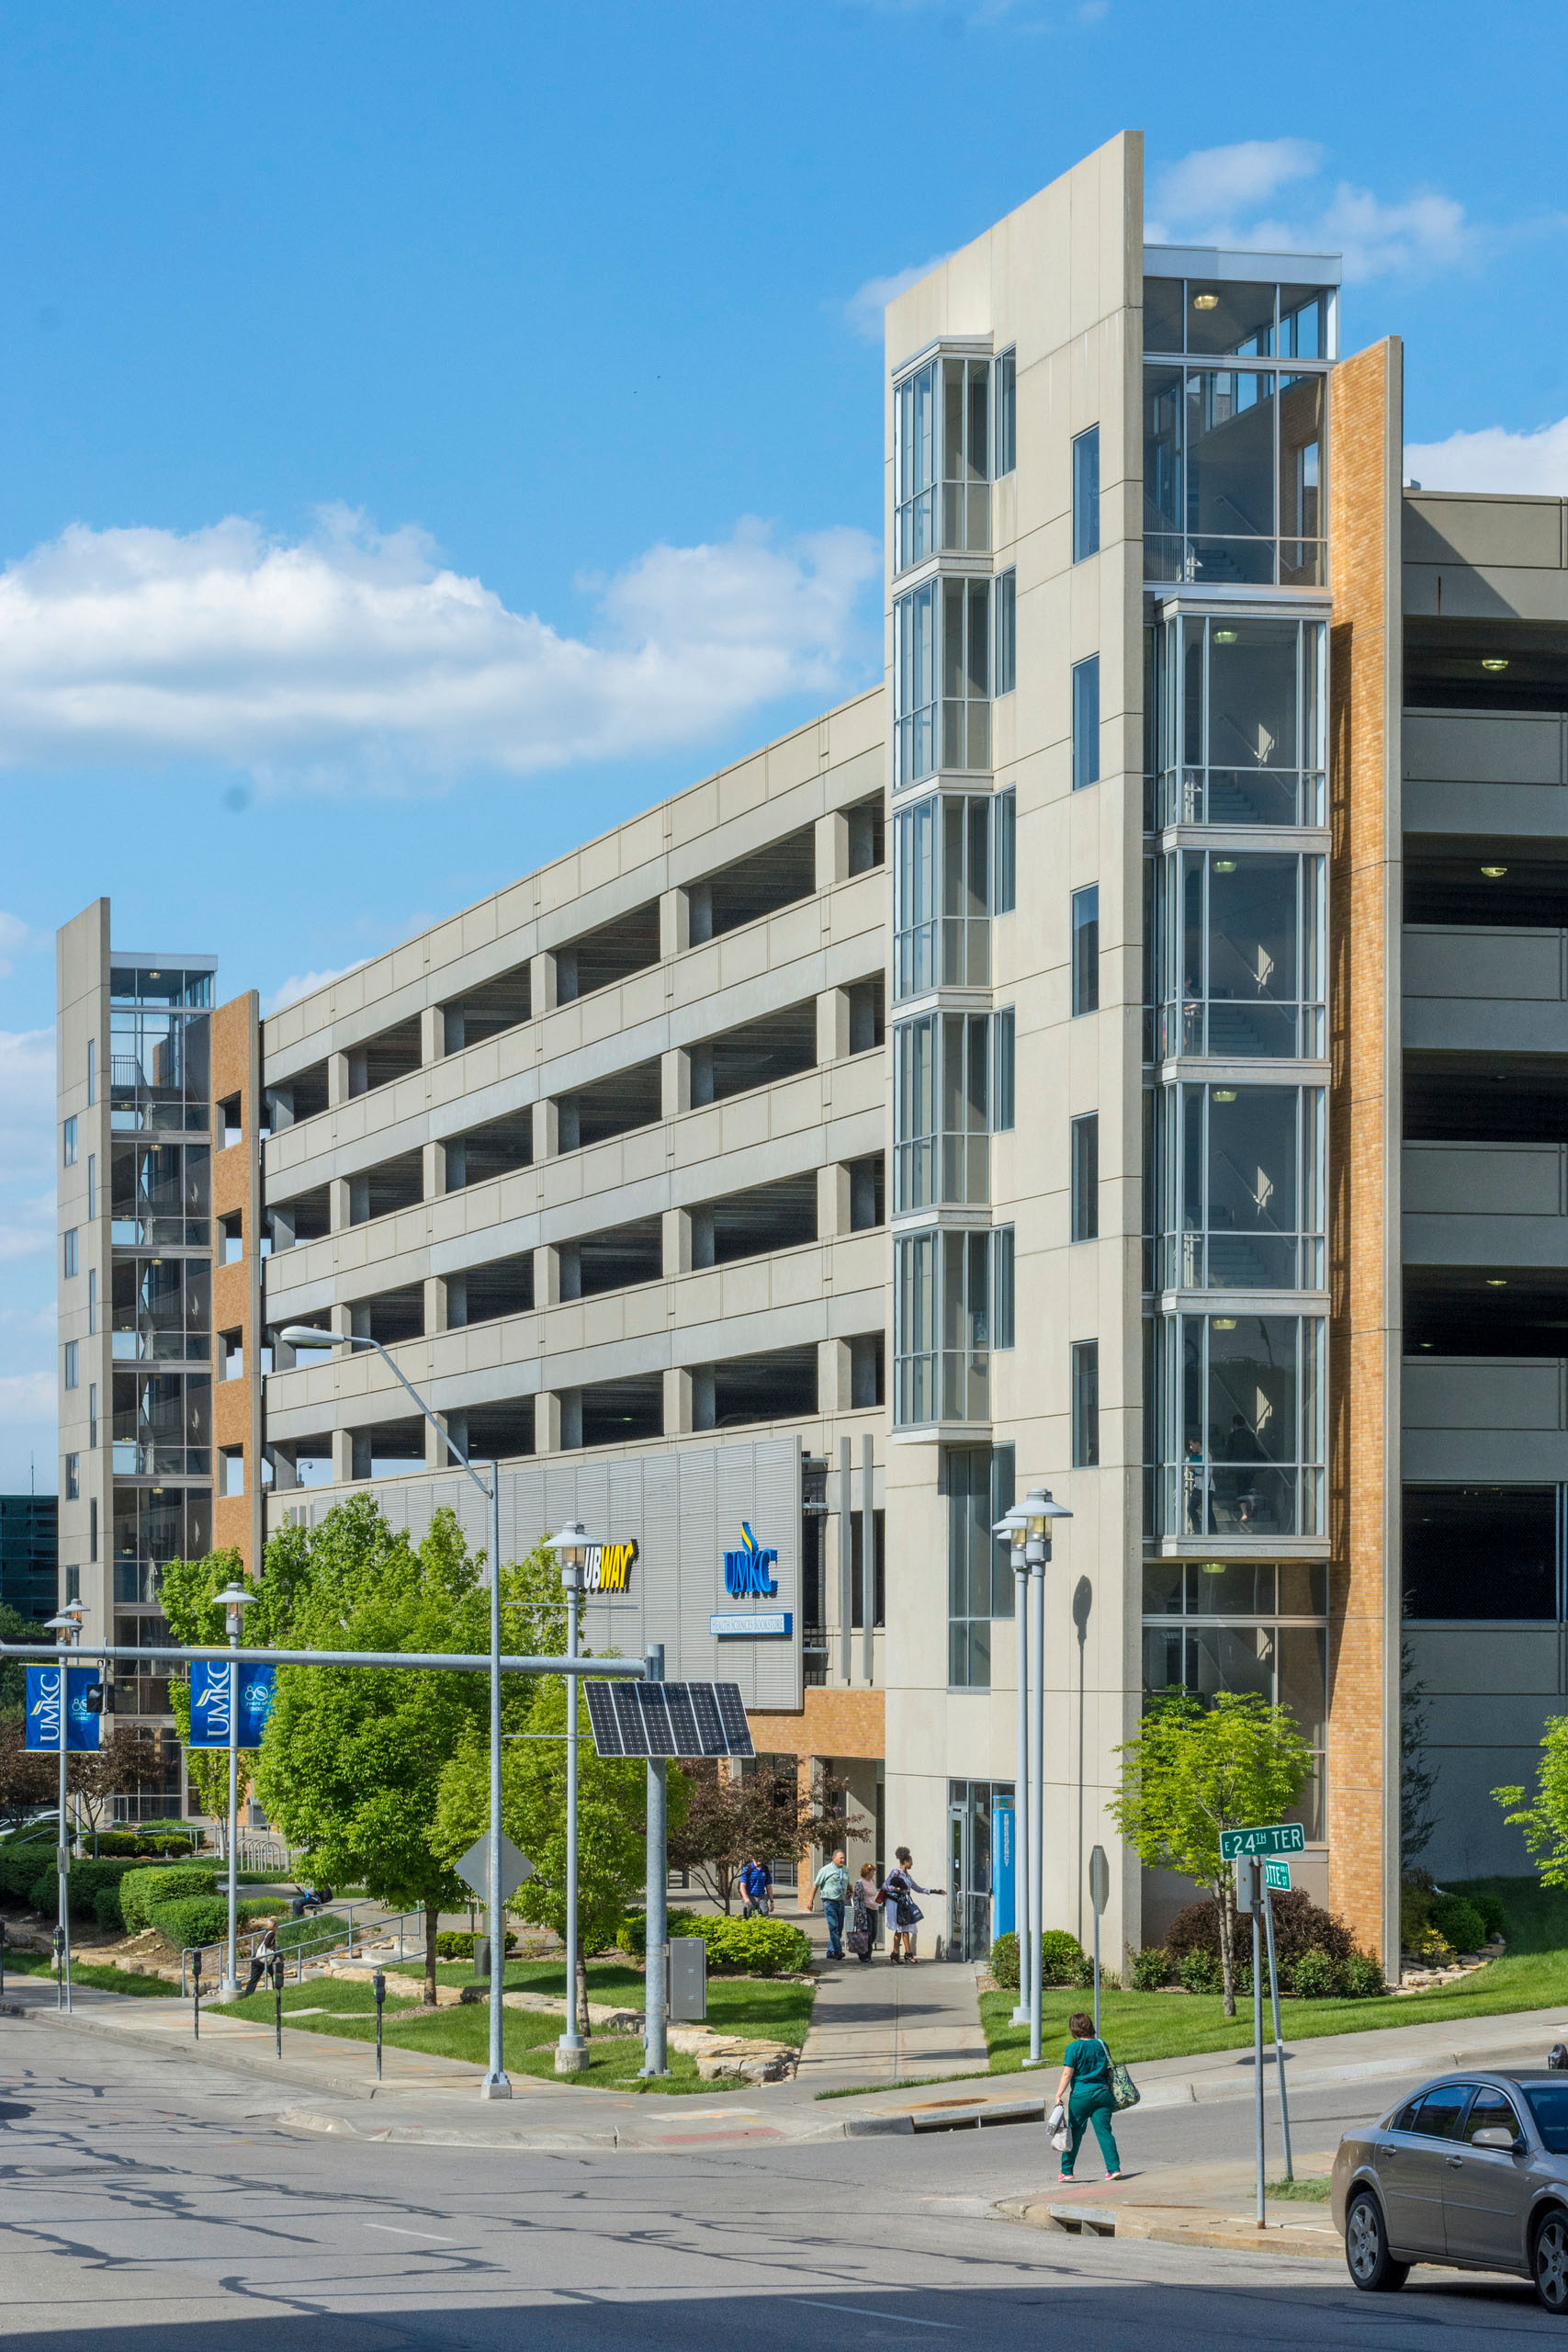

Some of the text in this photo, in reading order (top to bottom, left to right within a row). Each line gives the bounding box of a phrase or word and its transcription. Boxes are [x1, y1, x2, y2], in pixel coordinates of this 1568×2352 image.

[583, 1540, 634, 1589] UBWAY
[723, 1548, 778, 1594] UMKC
[754, 1616, 783, 1630] BOOKSTORE
[40, 1674, 60, 1742] UMKC
[207, 1661, 230, 1737] UMKC
[245, 1685, 268, 1701] 80
[1224, 1828, 1302, 1854] E 24TH TER
